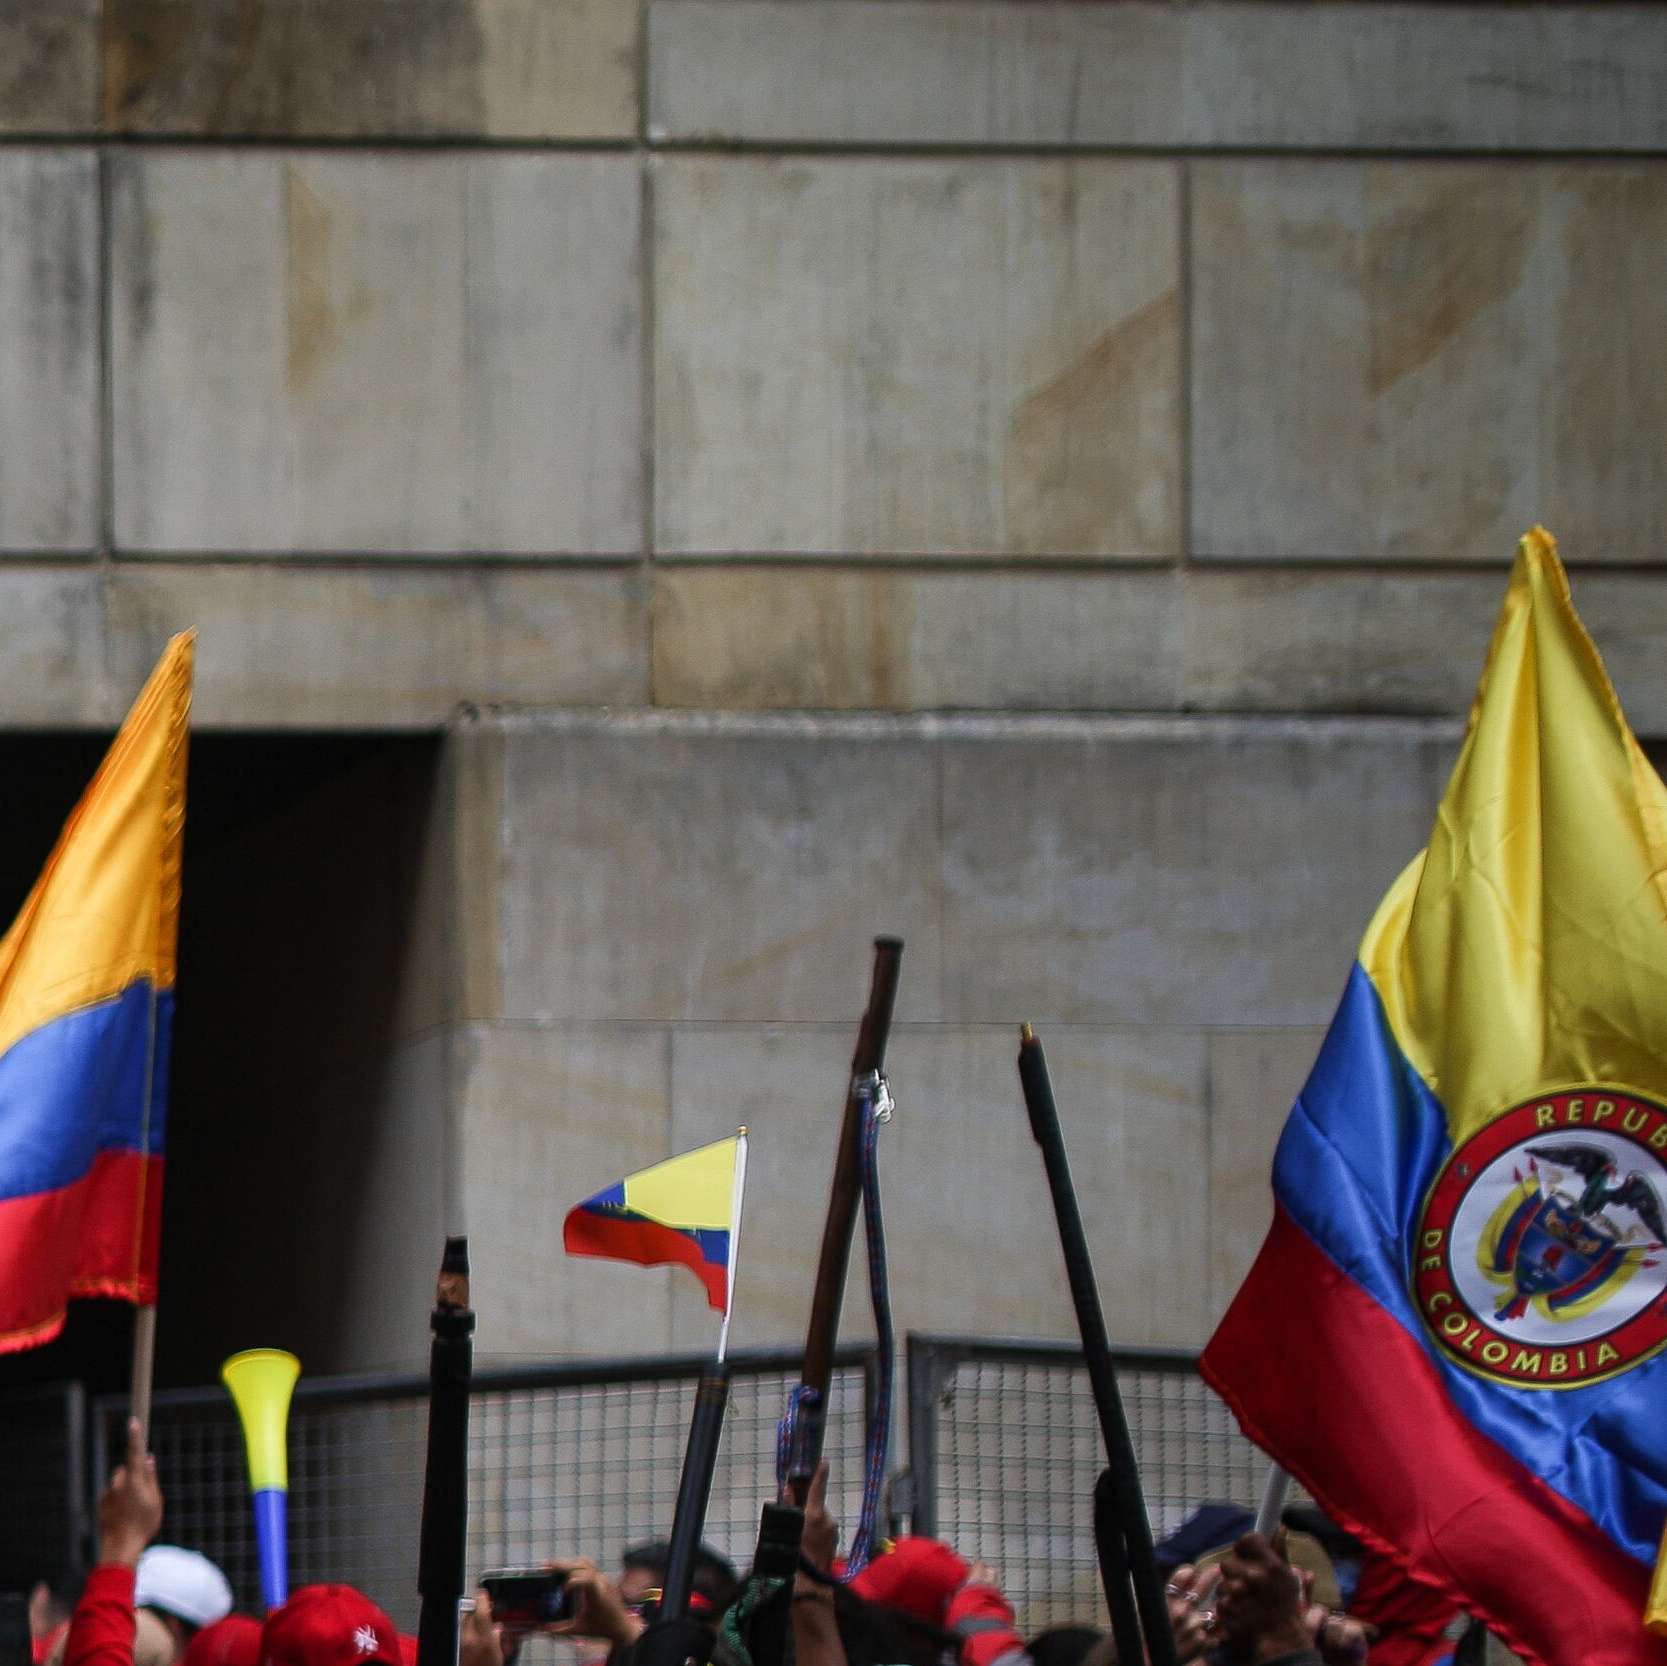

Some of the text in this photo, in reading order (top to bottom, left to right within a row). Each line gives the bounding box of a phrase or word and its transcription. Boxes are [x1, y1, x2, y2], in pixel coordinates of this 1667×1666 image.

[1421, 1228, 1619, 1375] DE COLOMBIA
[354, 1624, 379, 1655] NY
